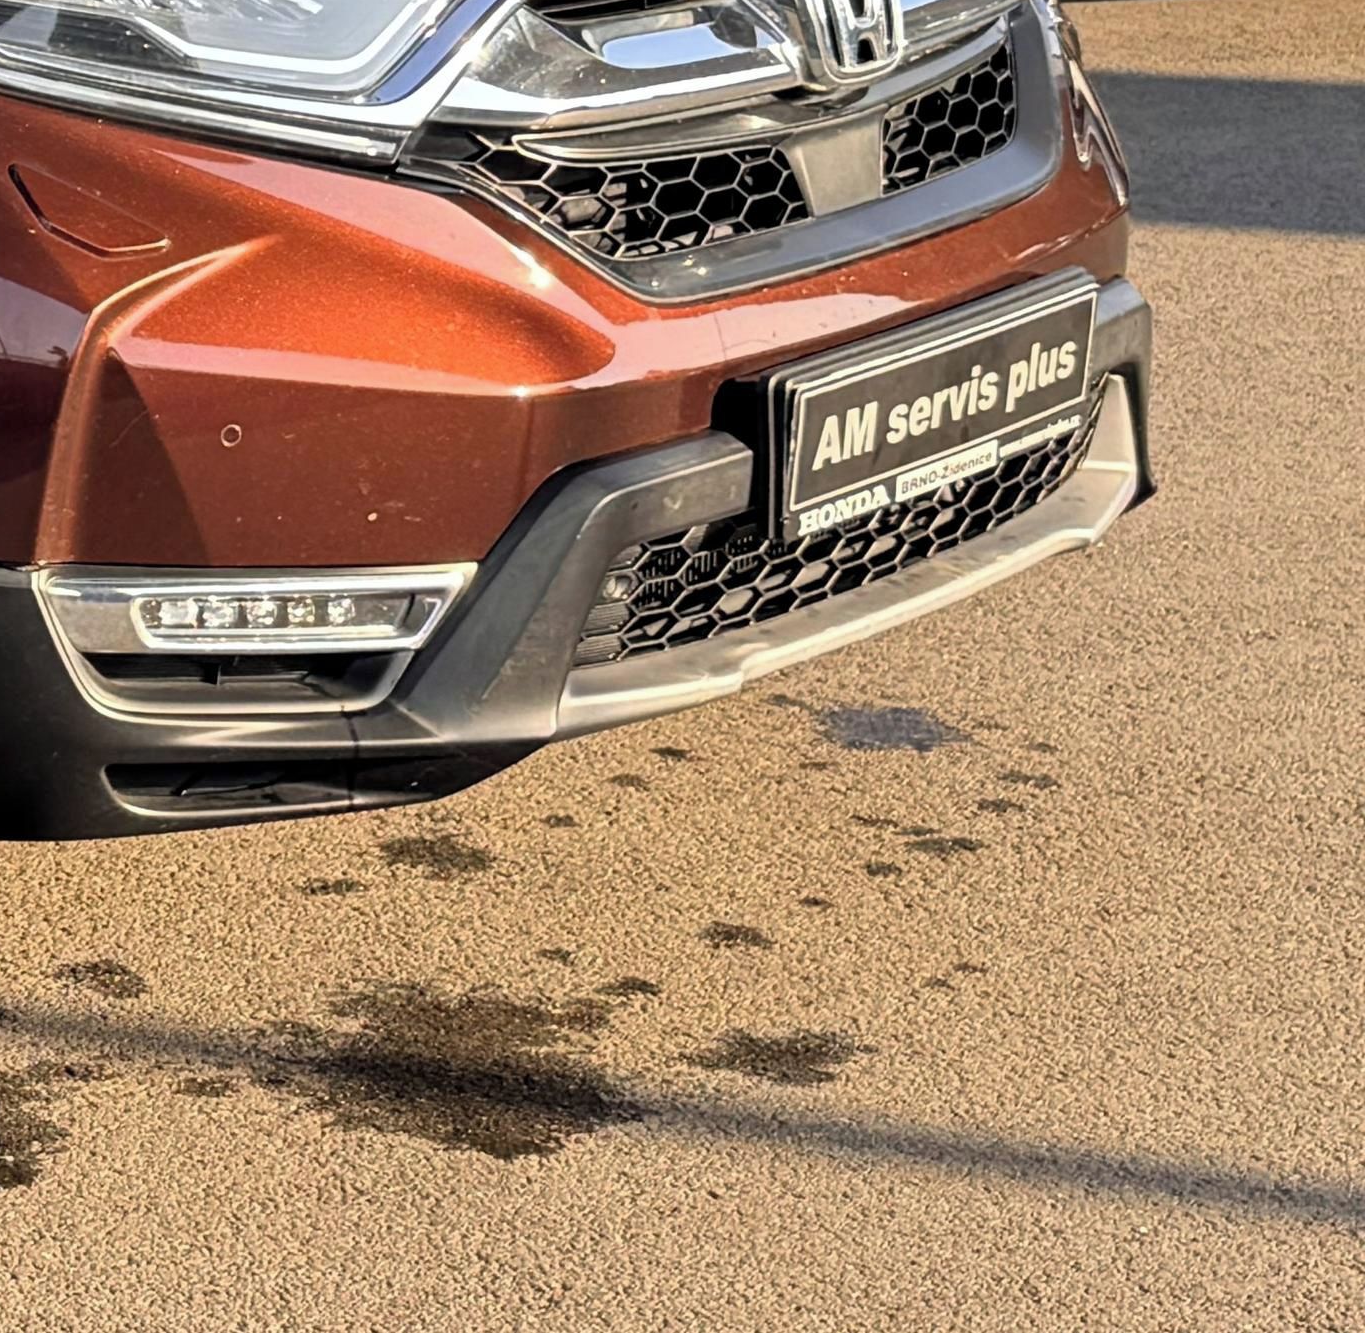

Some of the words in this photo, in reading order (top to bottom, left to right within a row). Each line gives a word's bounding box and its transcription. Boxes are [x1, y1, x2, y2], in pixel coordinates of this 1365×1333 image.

[812, 401, 878, 471] AM
[887, 365, 1001, 445] servis
[1005, 340, 1078, 413] plus
[798, 484, 891, 537] HONDA
